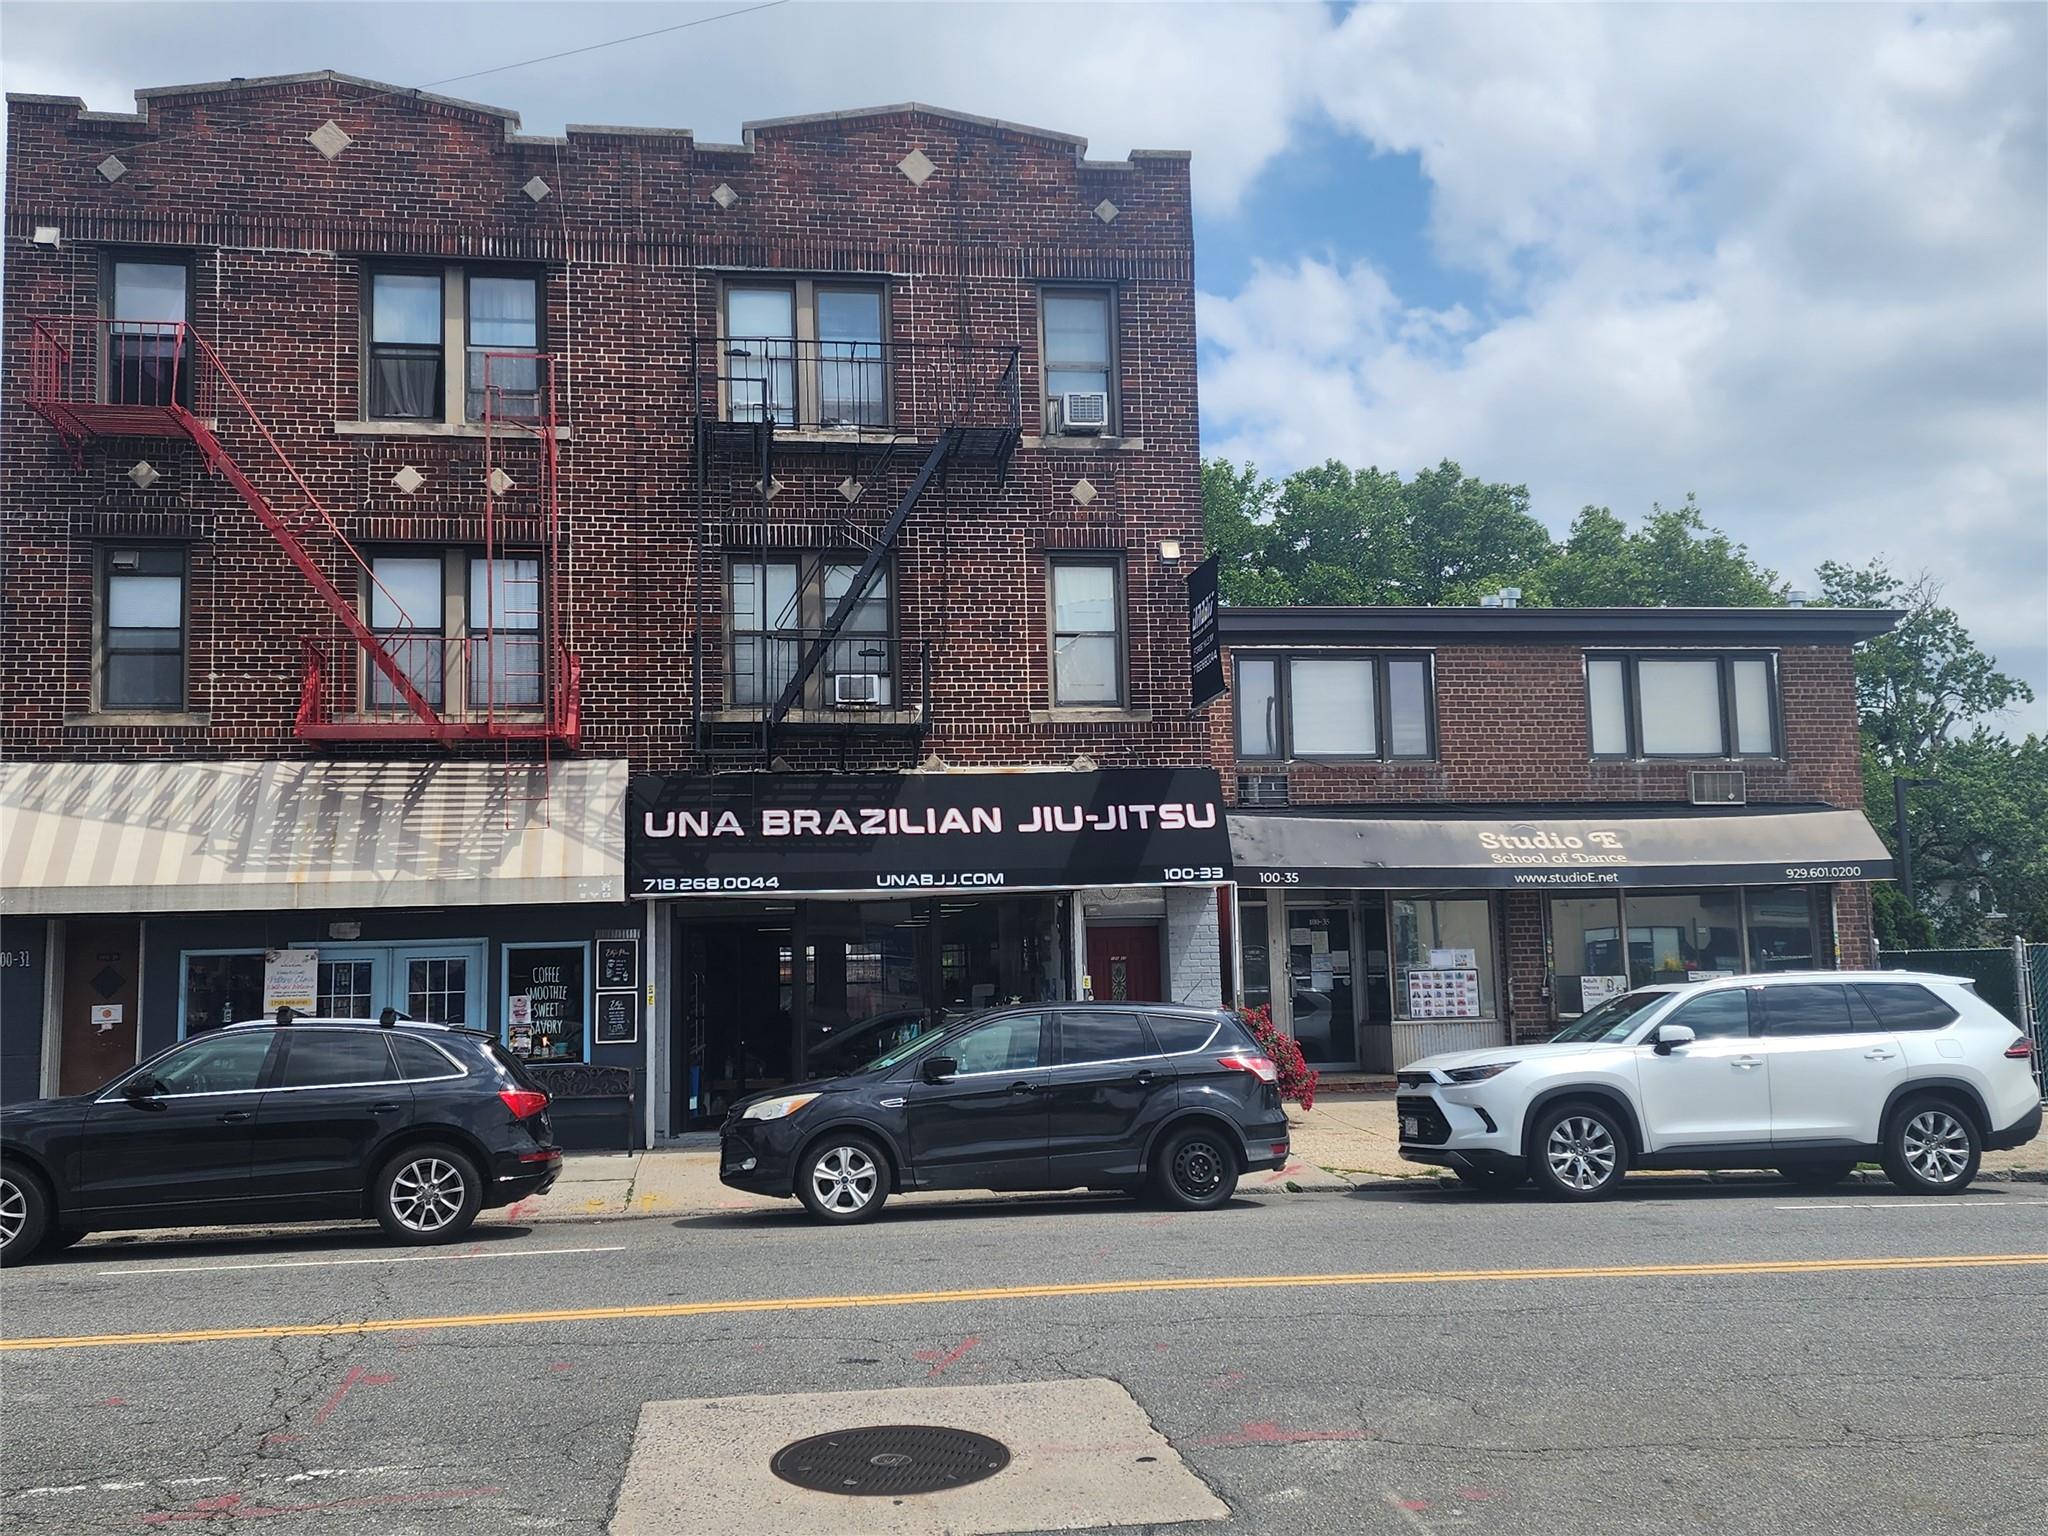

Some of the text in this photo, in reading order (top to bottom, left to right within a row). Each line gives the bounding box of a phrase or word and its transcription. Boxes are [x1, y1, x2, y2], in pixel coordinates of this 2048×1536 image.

[644, 802, 1217, 838] UNA BRAZILIAN JIU-JITSU
[1478, 831, 1624, 850] Studio E
[1491, 853, 1628, 864] School of Dance
[876, 872, 1004, 887] UNABJJ.COM
[1163, 867, 1224, 880] 100-33
[1259, 872, 1299, 883] 100-35
[1513, 872, 1619, 883] www.studioE.net
[1786, 866, 1861, 879] 929.601.0200
[643, 876, 780, 891] 718.268.0044
[532, 966, 560, 983] COFFEE
[525, 985, 568, 1001] SMOOTHIE
[533, 1002, 560, 1017] SWEET
[530, 1020, 563, 1034] SAVORY
